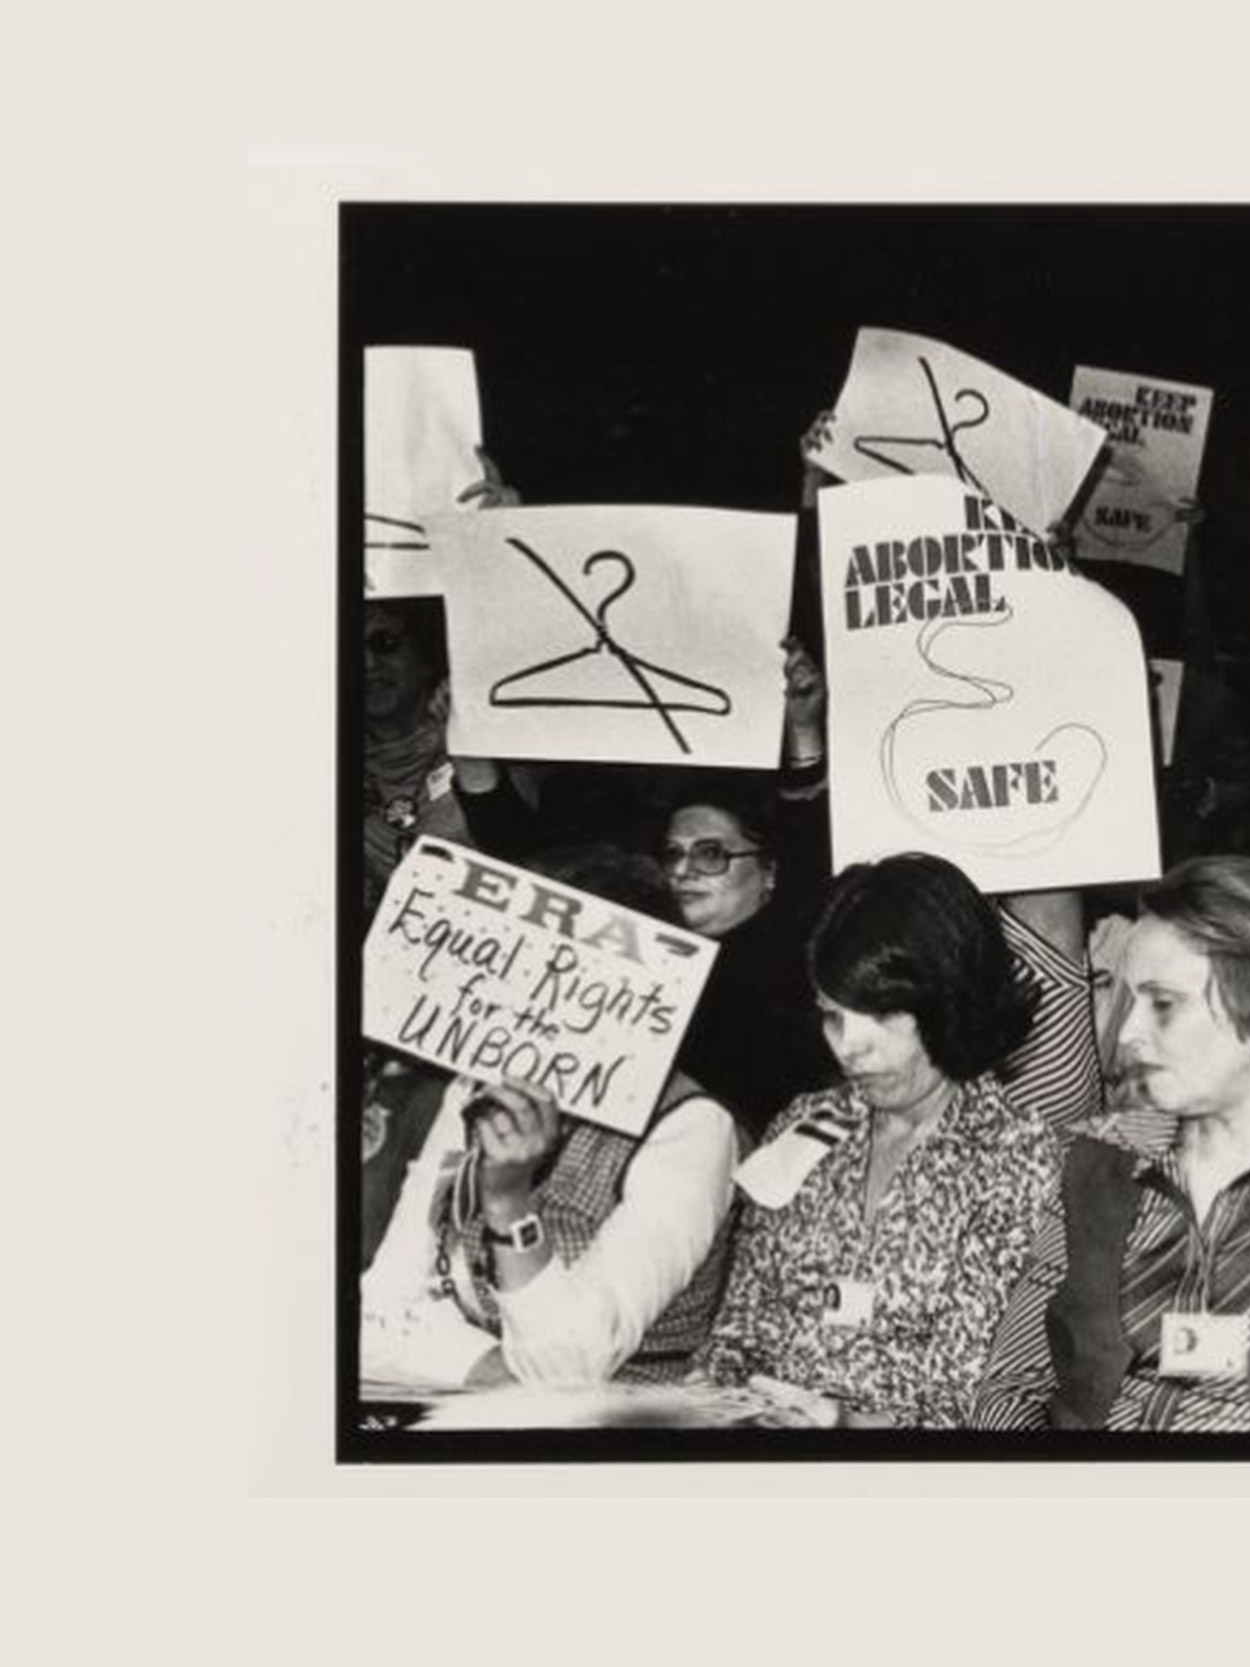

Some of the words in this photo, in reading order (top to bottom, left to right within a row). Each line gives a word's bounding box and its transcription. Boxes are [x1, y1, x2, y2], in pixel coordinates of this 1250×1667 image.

[1077, 396, 1195, 434] ABORTION
[1135, 384, 1198, 413] KEEP
[1094, 505, 1152, 533] SAFE
[845, 574, 1005, 630] LEGAL
[925, 760, 1059, 812] SAFE
[453, 857, 645, 965] ERA
[388, 887, 525, 982] Equal
[530, 943, 677, 1034] Rights
[450, 973, 502, 1018] for
[512, 1008, 560, 1041] the
[398, 995, 630, 1108] UNBORN
